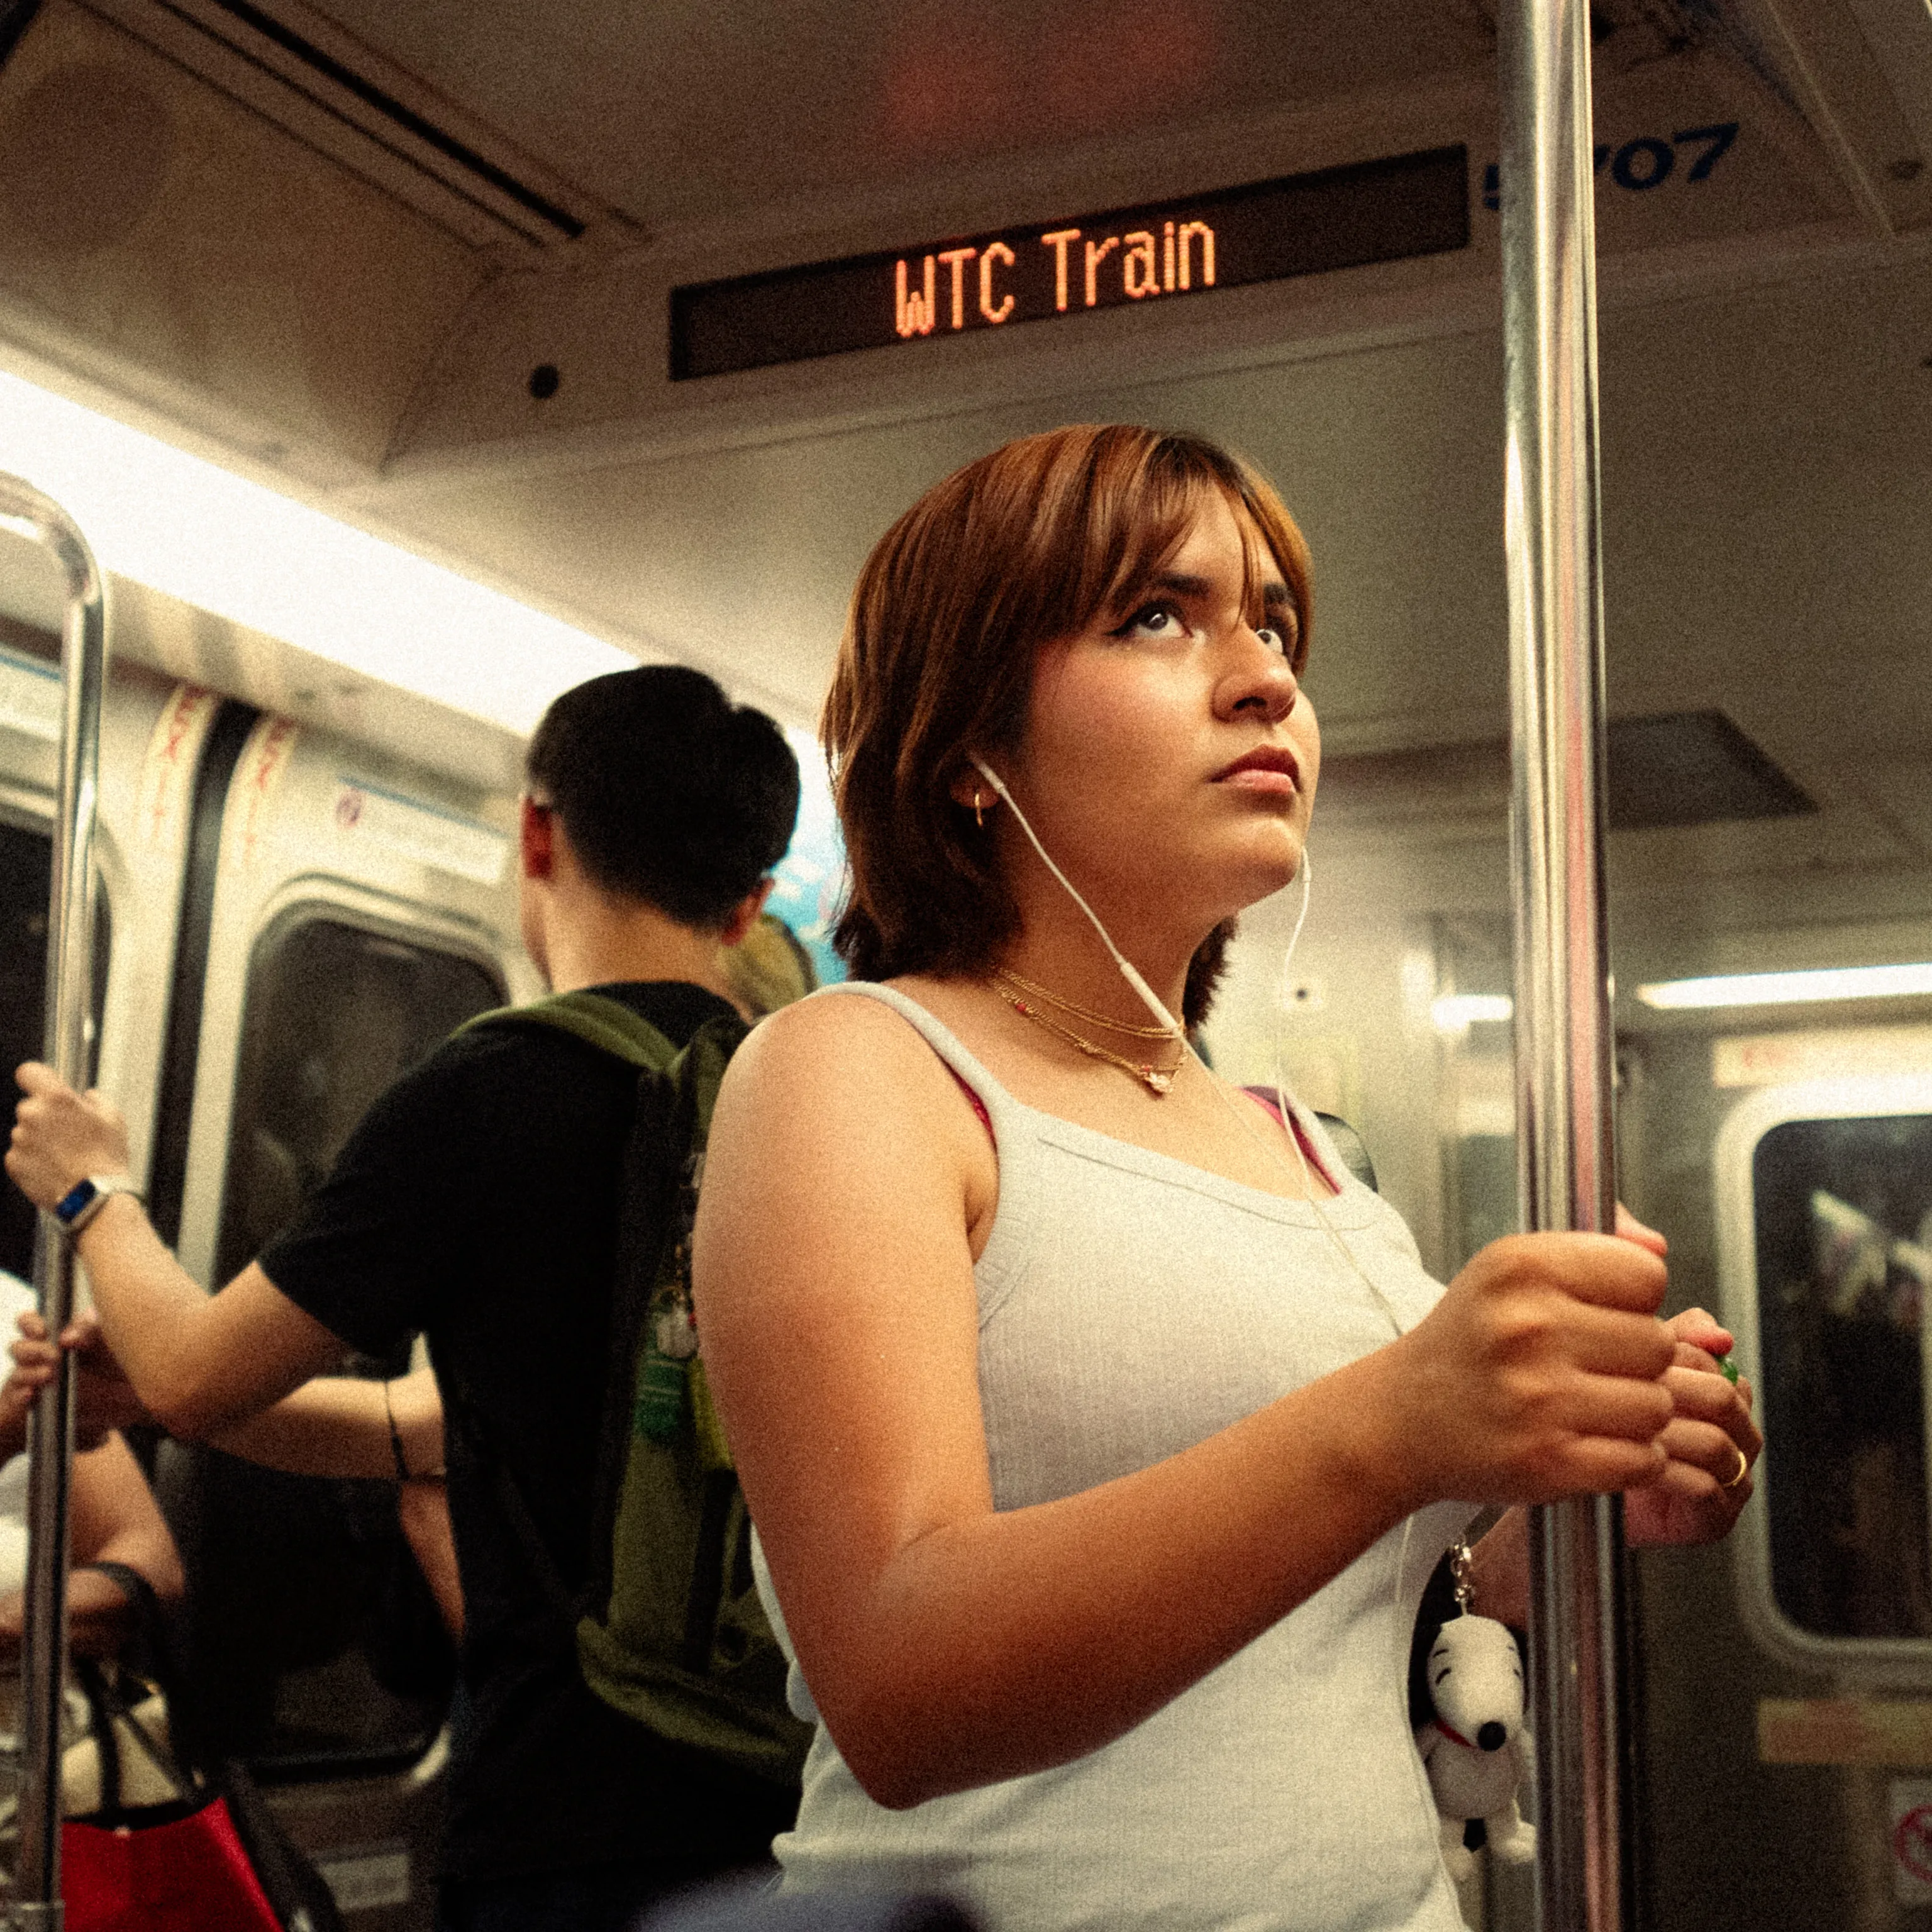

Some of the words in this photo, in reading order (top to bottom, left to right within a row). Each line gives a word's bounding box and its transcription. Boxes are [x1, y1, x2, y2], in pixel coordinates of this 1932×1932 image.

[1484, 122, 1740, 210] 07
[894, 242, 1016, 338] WTC
[1040, 220, 1216, 312] Train
